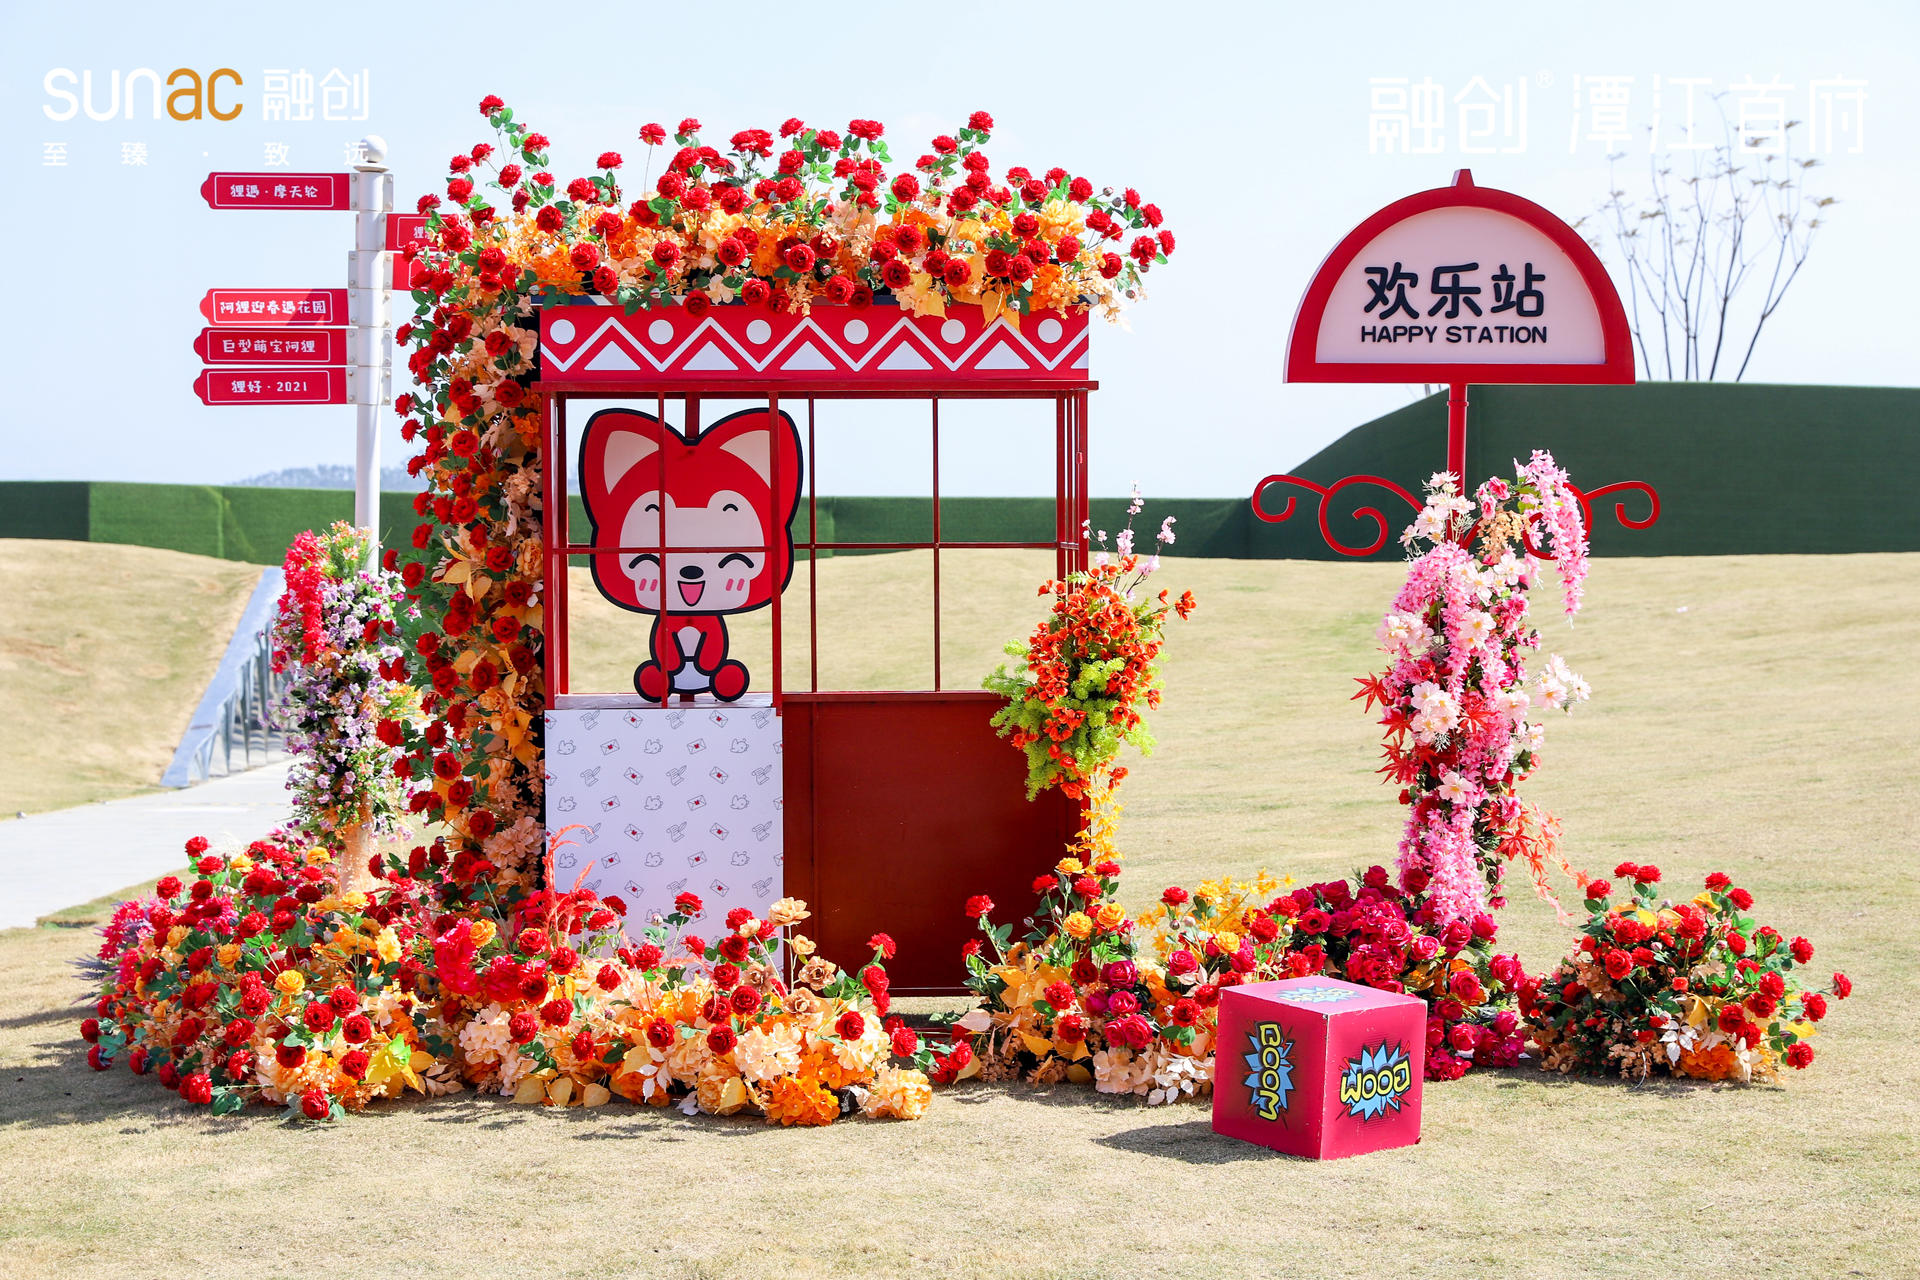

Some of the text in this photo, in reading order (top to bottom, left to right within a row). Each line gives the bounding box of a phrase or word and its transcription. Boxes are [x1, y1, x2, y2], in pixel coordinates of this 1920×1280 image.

[1363, 262, 1546, 319] 欢乐站
[222, 339, 316, 354] 巨型萌宝阿狸
[1361, 325, 1548, 344] HAPPY STATION
[1258, 1023, 1281, 1121] BOOM
